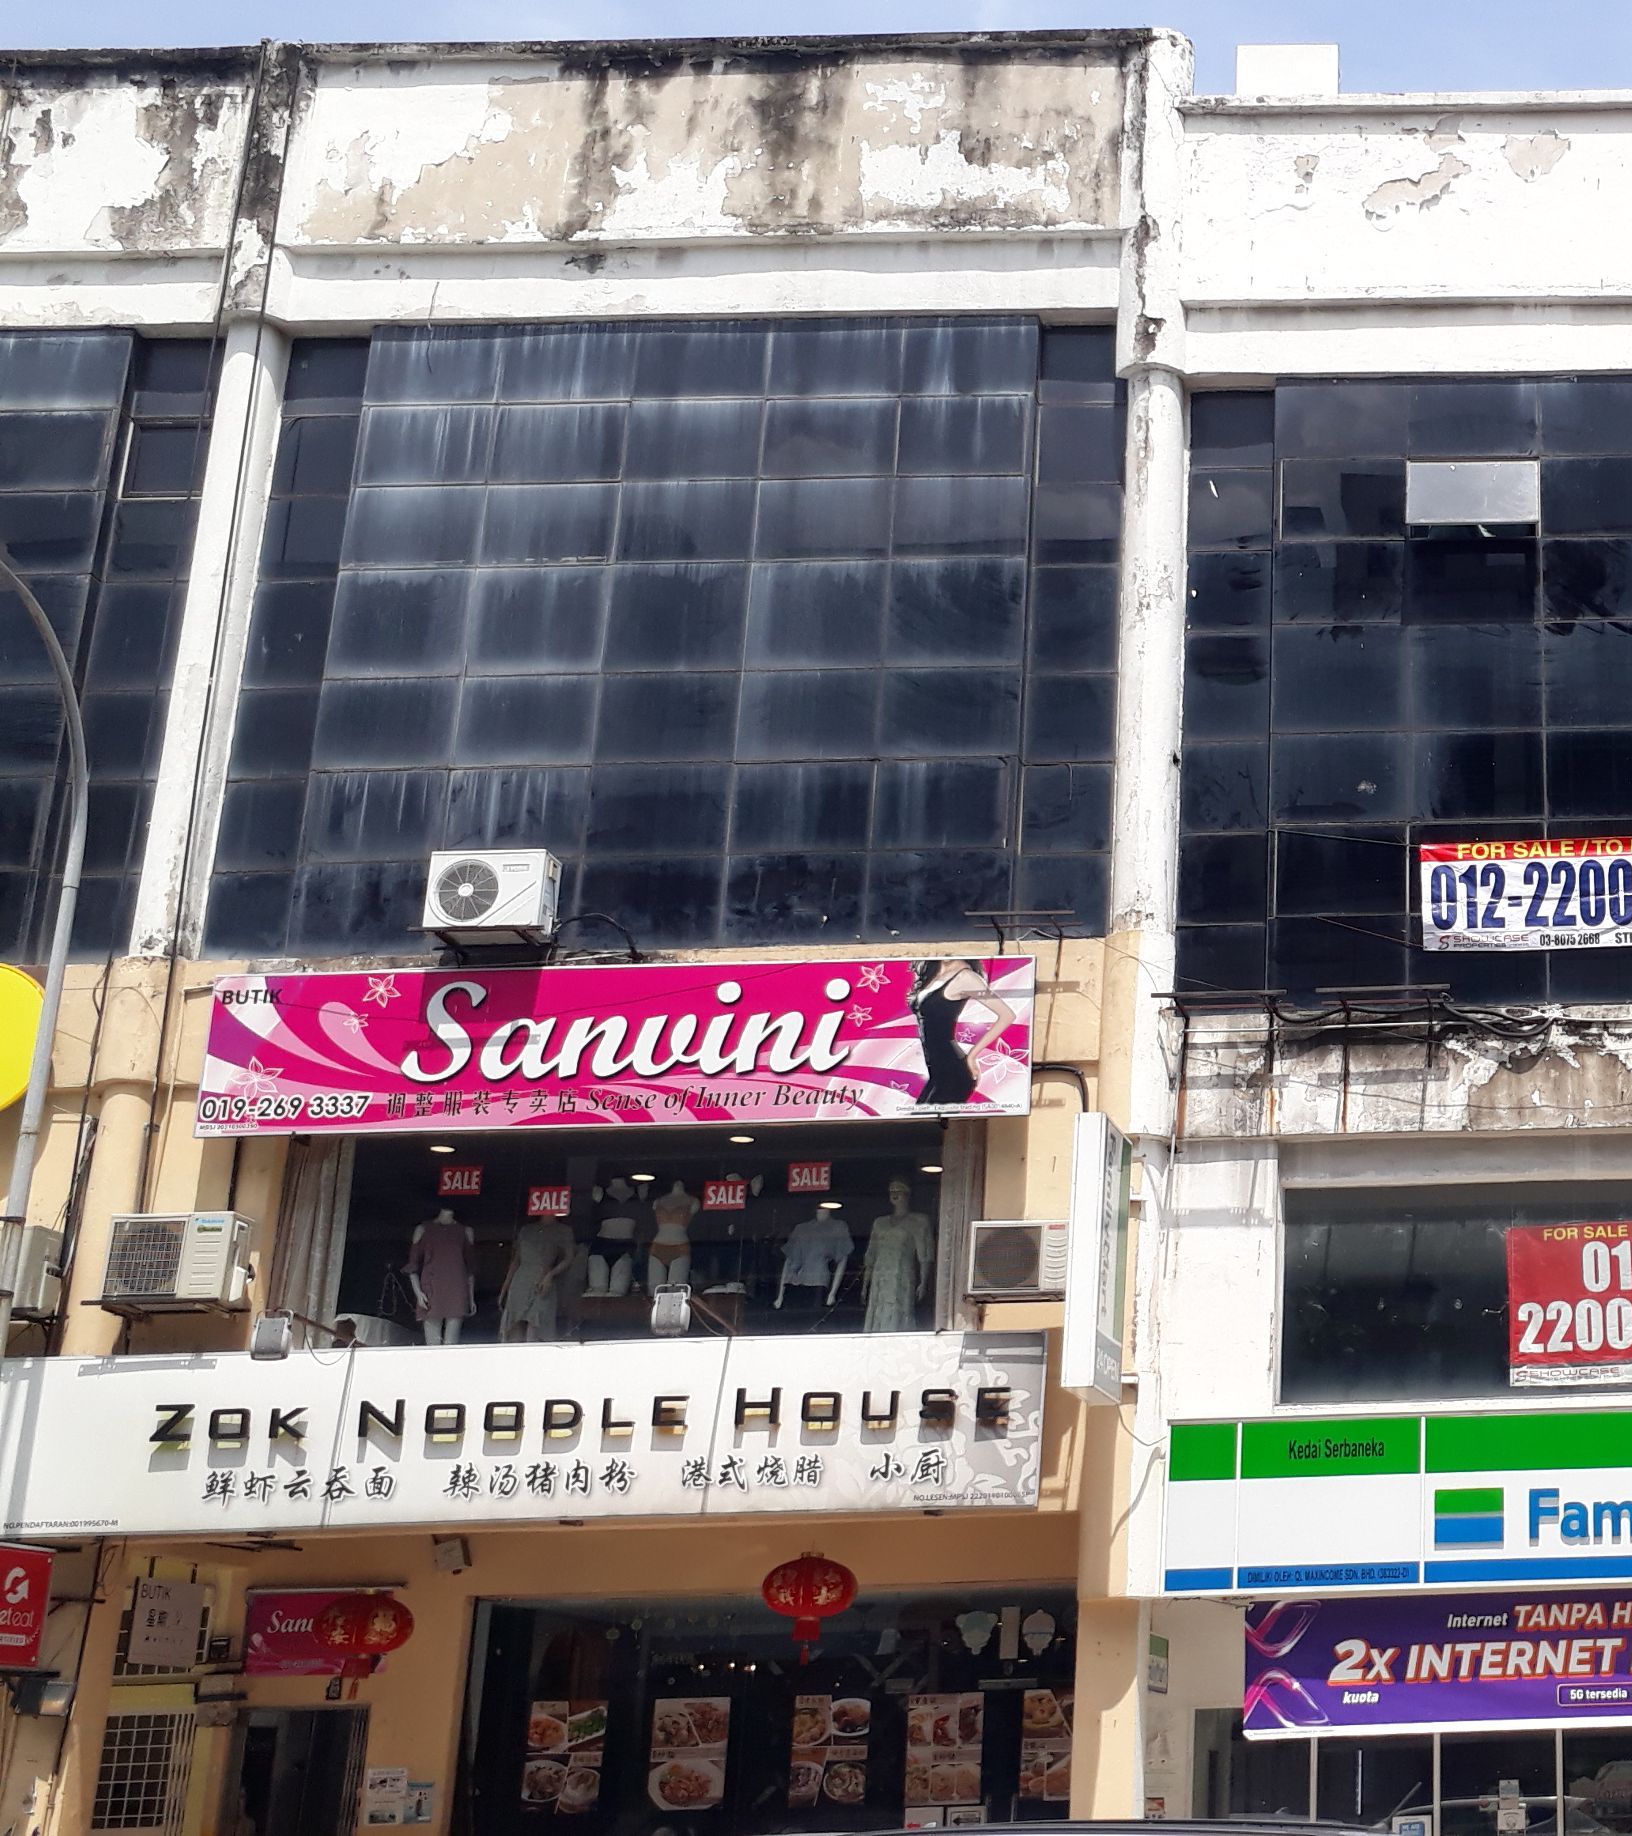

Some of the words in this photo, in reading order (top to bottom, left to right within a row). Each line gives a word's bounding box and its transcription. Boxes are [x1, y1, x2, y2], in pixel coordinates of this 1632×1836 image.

[1456, 843, 1507, 860] FOR
[1512, 840, 1576, 859] SALE
[1594, 839, 1624, 858] TO
[1539, 933, 1576, 947] 03-8075
[1577, 932, 1601, 946] 2668
[221, 989, 284, 1006] BUTIK
[399, 978, 852, 1085] Sanvini
[202, 1096, 302, 1119] 019-269
[310, 1094, 371, 1117] 3337
[586, 1088, 657, 1112] Sense
[664, 1084, 692, 1114] of
[695, 1087, 767, 1110] Inner
[775, 1085, 865, 1110] Beauty
[442, 1170, 481, 1192] SALE
[790, 1166, 831, 1189] SALE
[531, 1191, 570, 1213] SALE
[706, 1185, 746, 1207] SALE
[1543, 1227, 1579, 1241] FOR
[1583, 1224, 1629, 1240] SALE
[149, 1403, 308, 1443] ZOK
[357, 1395, 690, 1439] NOODLE
[734, 1385, 1012, 1428] HOUSE
[1288, 1438, 1322, 1461] Kedai
[1323, 1436, 1385, 1460] Serbaneka
[201, 1465, 397, 1504] 鲜虾云吞面
[441, 1457, 638, 1498] 辣汤猪肉粉
[680, 1452, 826, 1490] 港式烧腊
[869, 1446, 948, 1486] 小厨
[1447, 1612, 1508, 1629] Internet
[1515, 1602, 1604, 1630] TANPA
[1405, 1636, 1625, 1681] INTERNET
[1342, 1690, 1380, 1705] kuota
[1569, 1689, 1584, 1700] 5G
[1586, 1687, 1628, 1700] tersedia
